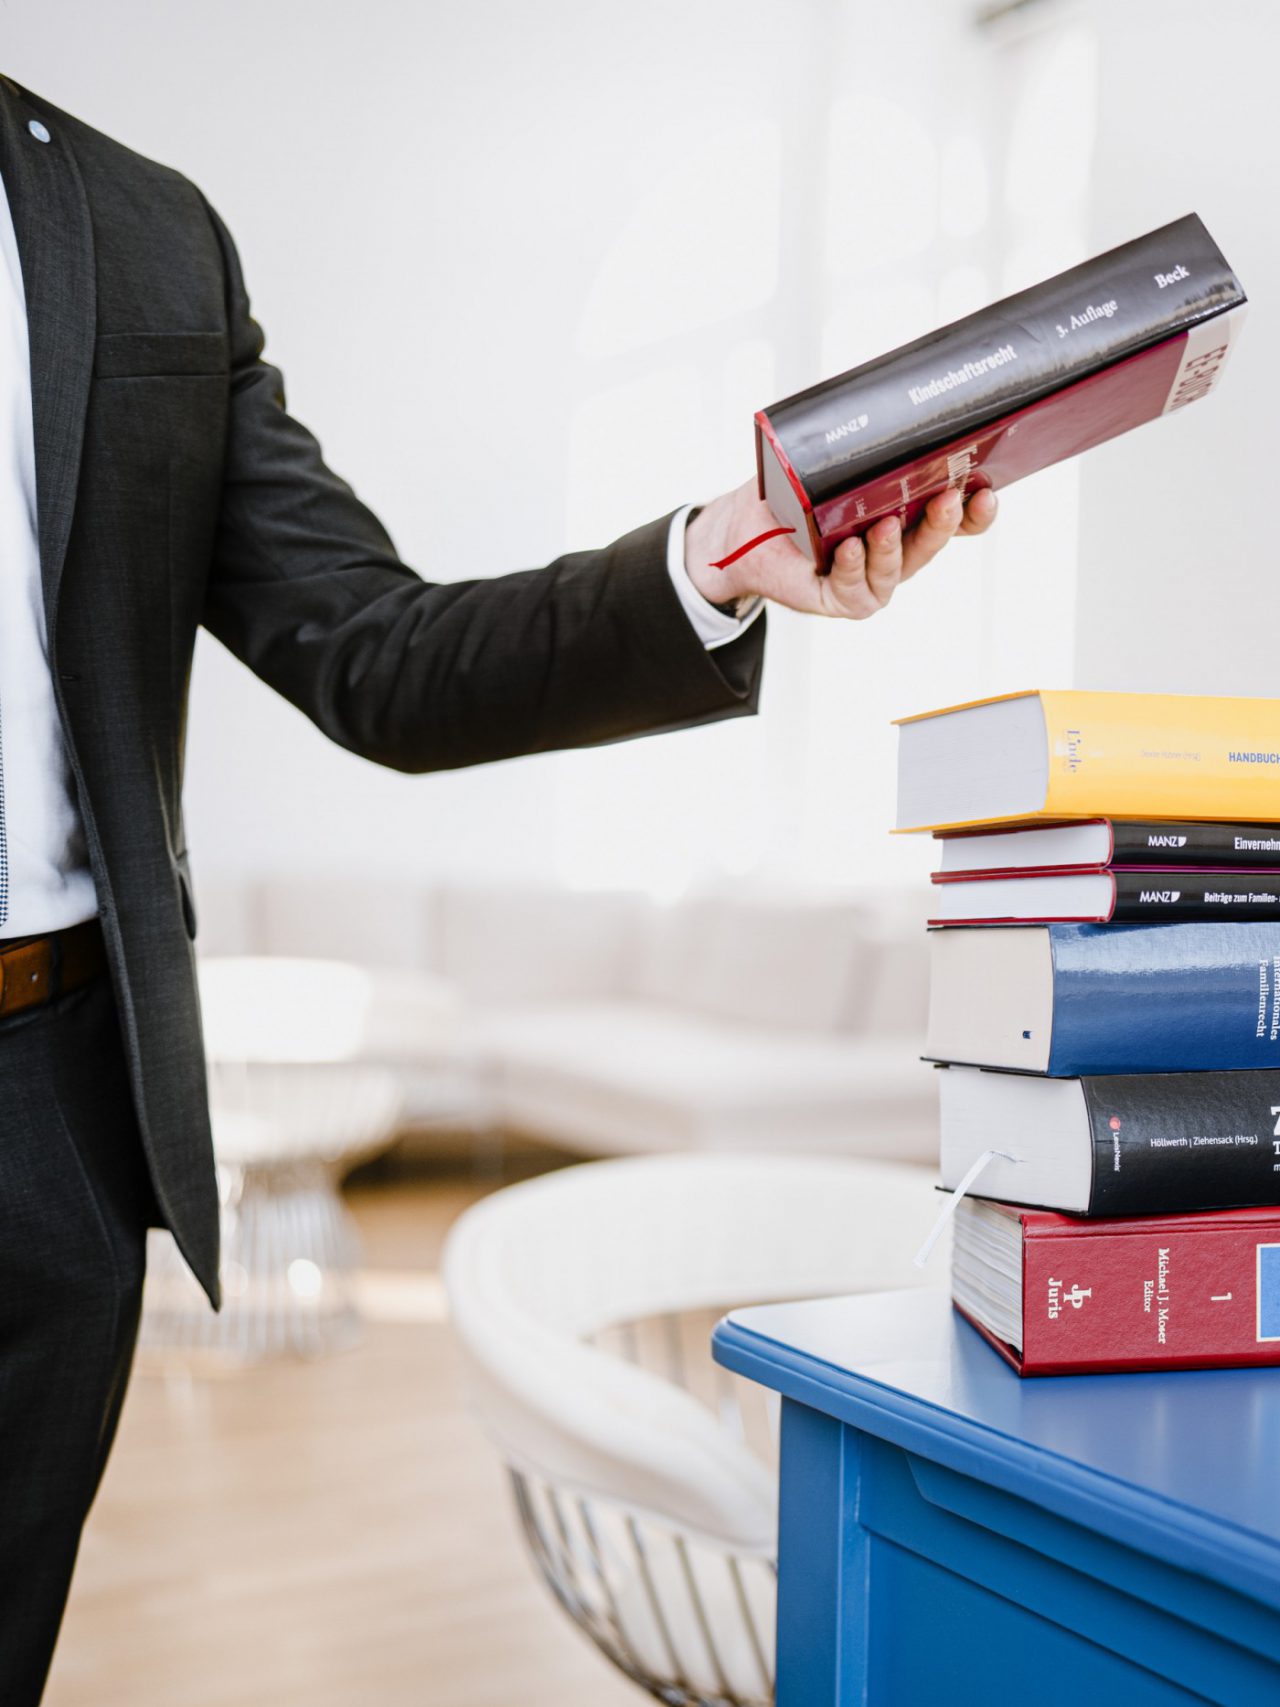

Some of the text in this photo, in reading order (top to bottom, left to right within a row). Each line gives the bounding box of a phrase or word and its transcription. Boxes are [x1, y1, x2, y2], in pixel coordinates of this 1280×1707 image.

[1154, 265, 1190, 289] Beck
[1056, 300, 1119, 339] 3. Auflage
[908, 344, 1019, 405] Kindschaftsrecht
[825, 419, 861, 444] MANZ
[1148, 836, 1178, 847] MANZ
[1140, 891, 1170, 903] MANZ
[1204, 892, 1233, 905] Beiträge
[1233, 895, 1248, 903] zum
[1248, 892, 1279, 903] Familien-
[1256, 959, 1269, 1038] Familienrecht
[1150, 1137, 1188, 1148] Höllwerth
[1193, 1135, 1234, 1146] Ziehensack
[1234, 1134, 1259, 1145] (Hrsg.)
[1048, 1277, 1063, 1319] Juris
[1144, 1280, 1154, 1312] Editor
[1157, 1248, 1170, 1344] Michael J. Moser
[1211, 1292, 1232, 1302] 1
